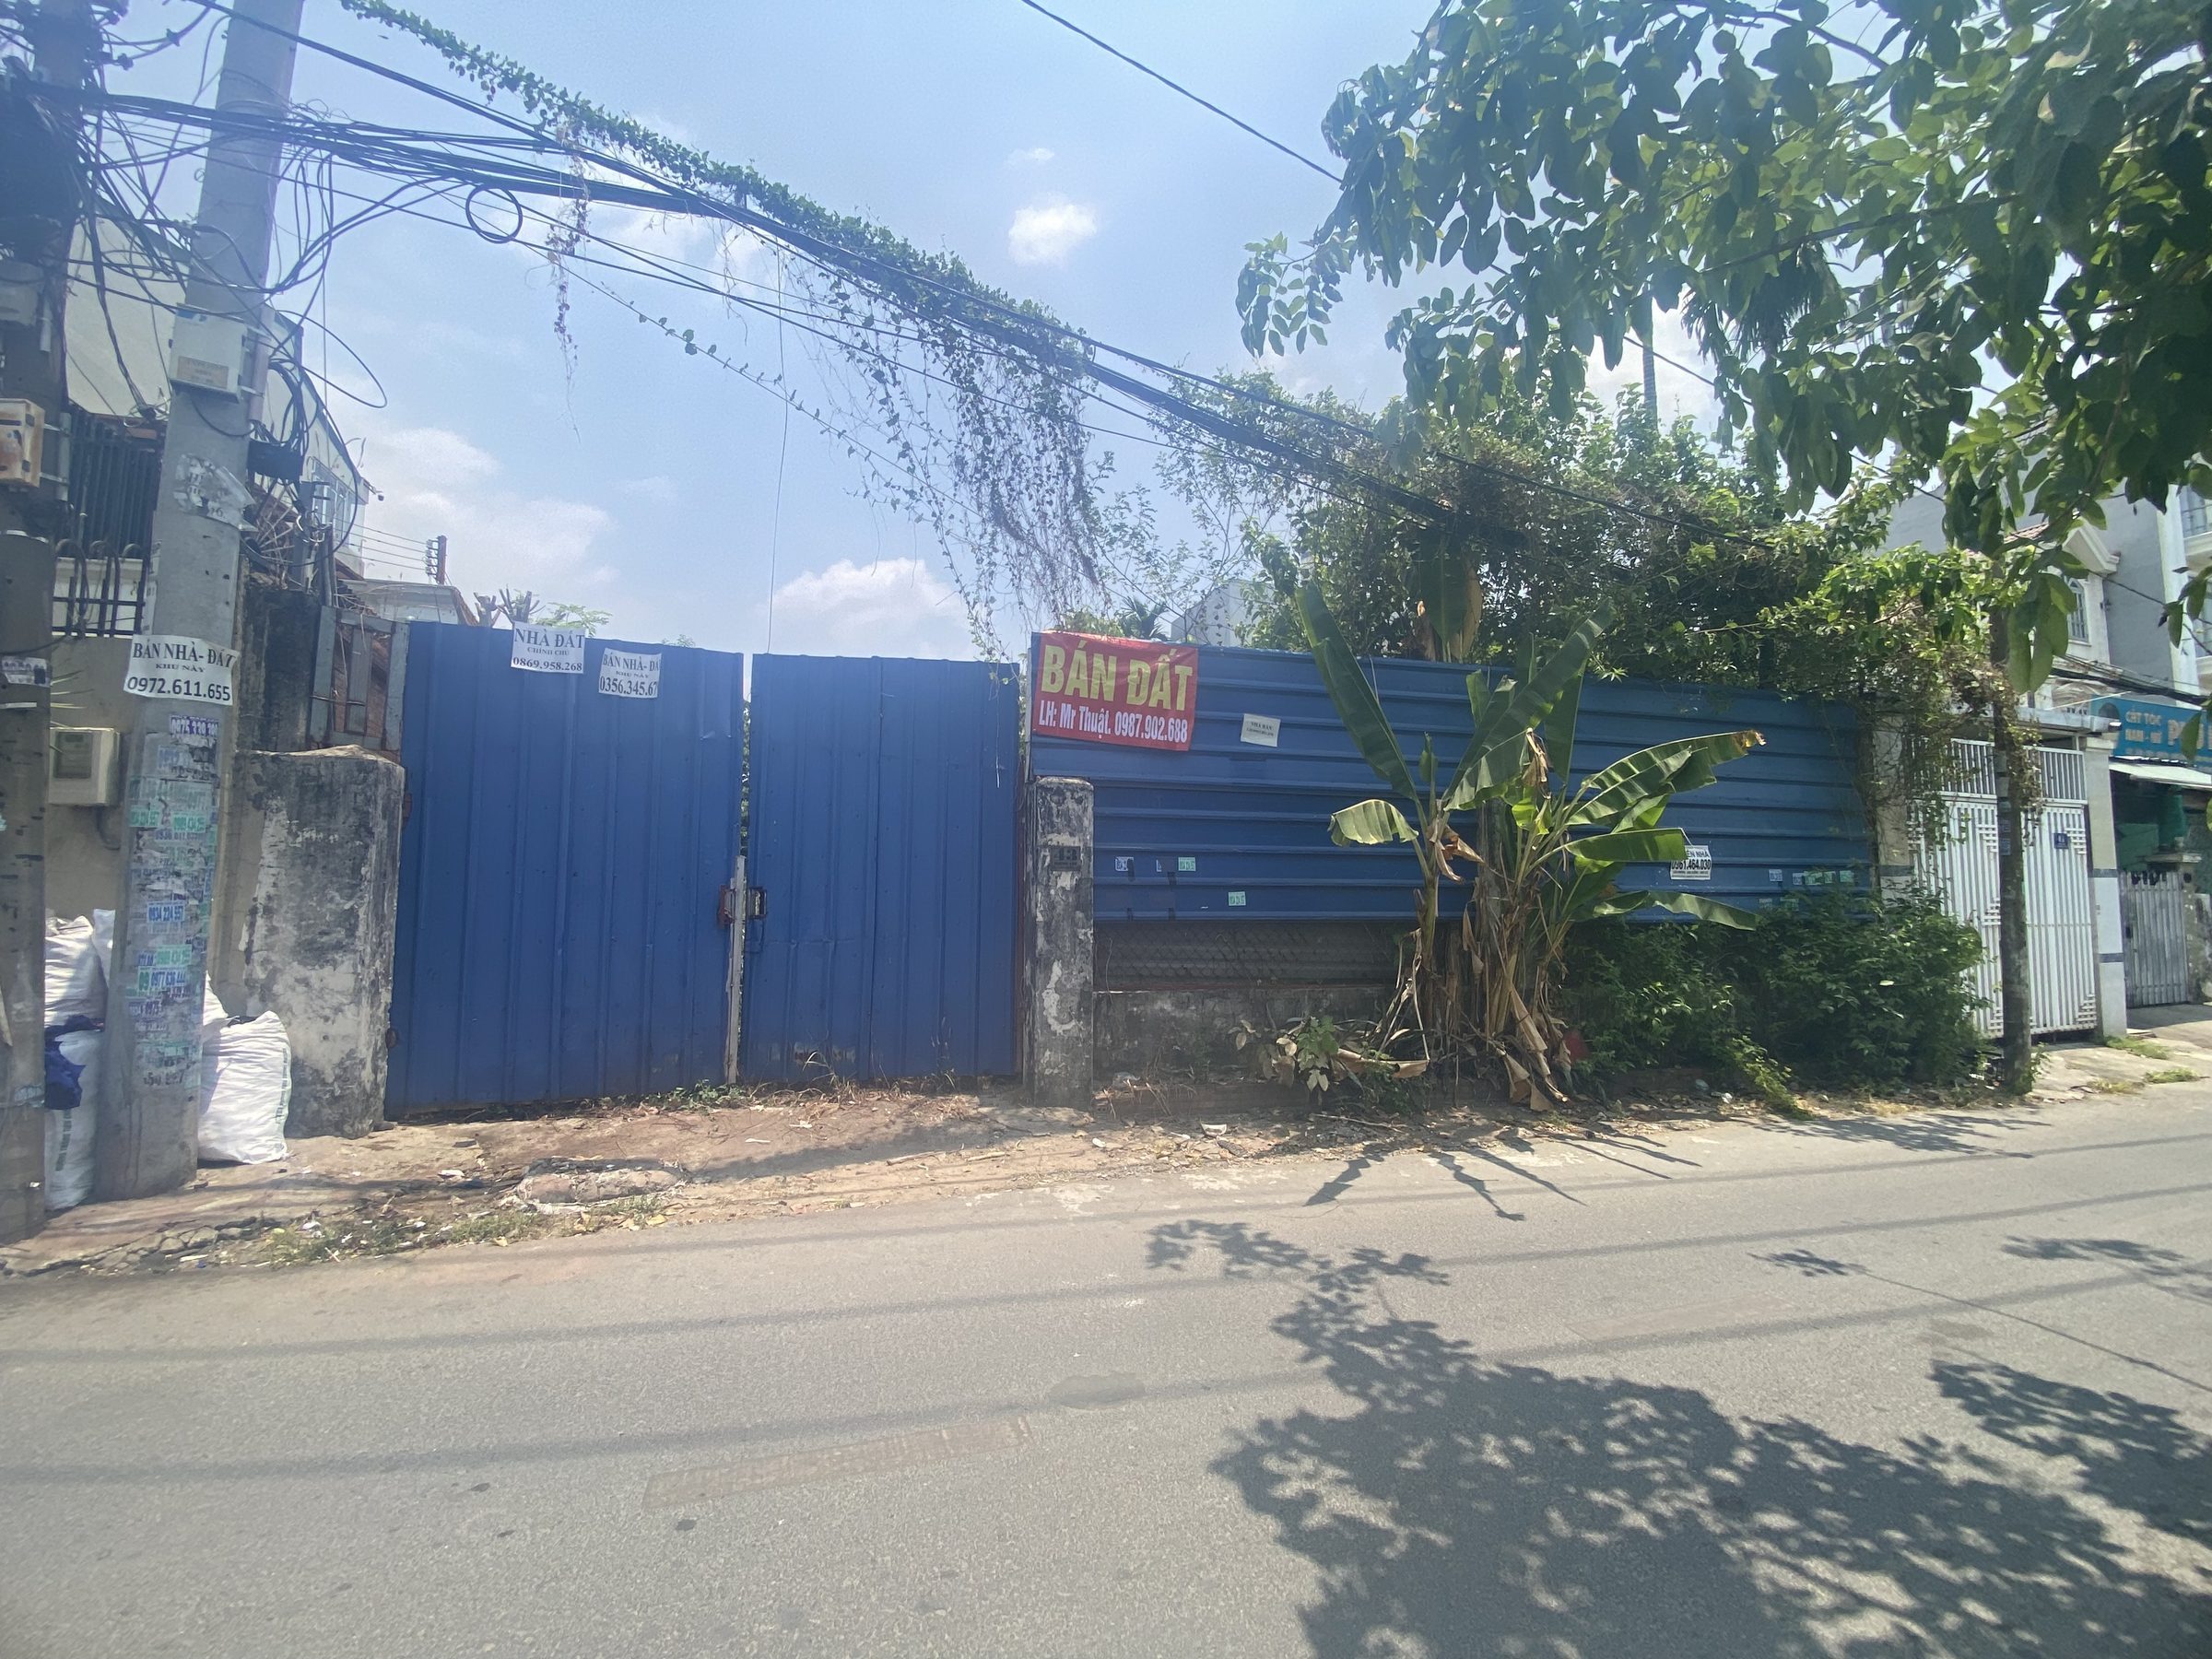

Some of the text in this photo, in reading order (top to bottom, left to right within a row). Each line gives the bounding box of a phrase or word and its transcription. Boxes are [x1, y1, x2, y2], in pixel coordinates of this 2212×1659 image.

[514, 628, 551, 647] NHÀ
[133, 639, 160, 659] BÁN
[512, 656, 582, 672] 0869.958.268
[603, 653, 620, 668] BÁN
[1041, 640, 1193, 711] BÁN ĐẤT
[127, 677, 230, 701] 0972.611.655
[1038, 700, 1056, 727] LH:
[1059, 702, 1077, 730] Mr
[1114, 711, 1188, 743] 0987.902.688
